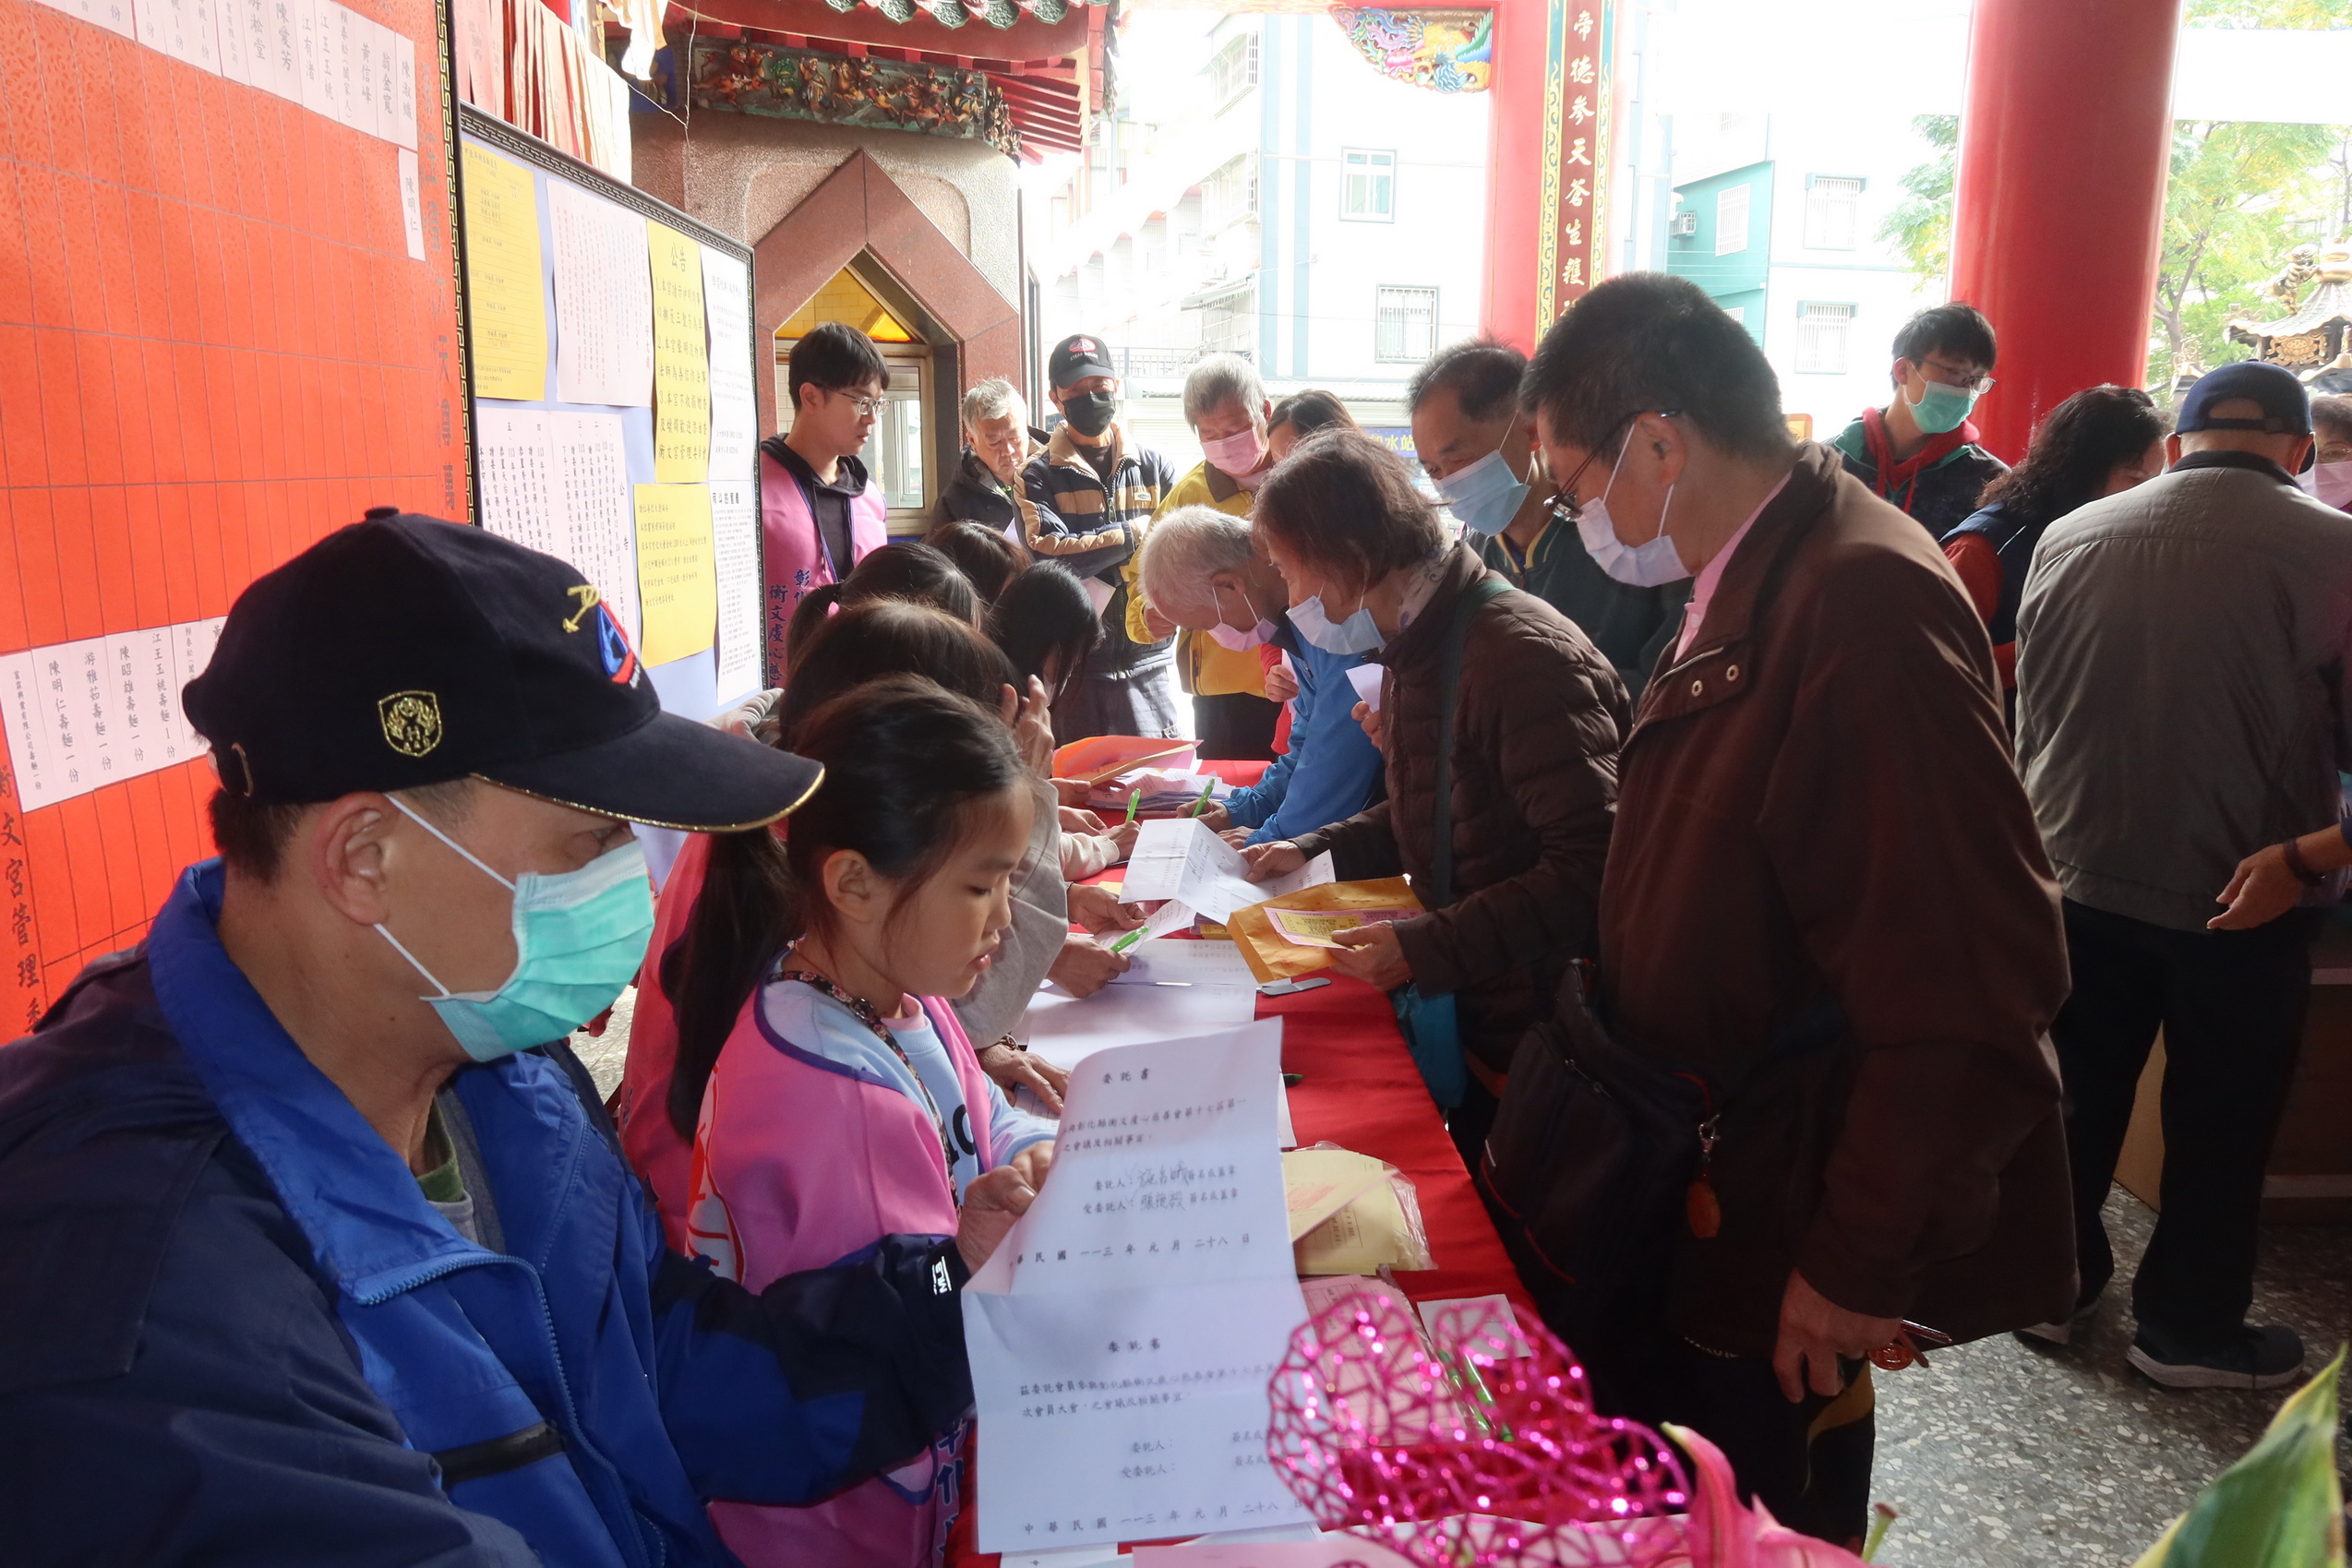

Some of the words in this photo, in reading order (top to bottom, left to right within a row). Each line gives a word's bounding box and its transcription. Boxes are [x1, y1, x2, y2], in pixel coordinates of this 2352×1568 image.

[275, 2, 292, 71] 陳愛芳
[405, 175, 418, 231] 陳明仁
[671, 243, 686, 272] 公告
[49, 660, 79, 784] 陳明仁壽麵一份
[120, 646, 144, 761] 陳昭雄壽麵一份
[1102, 1068, 1150, 1084] 委託書
[1108, 1337, 1161, 1353] 委託書
